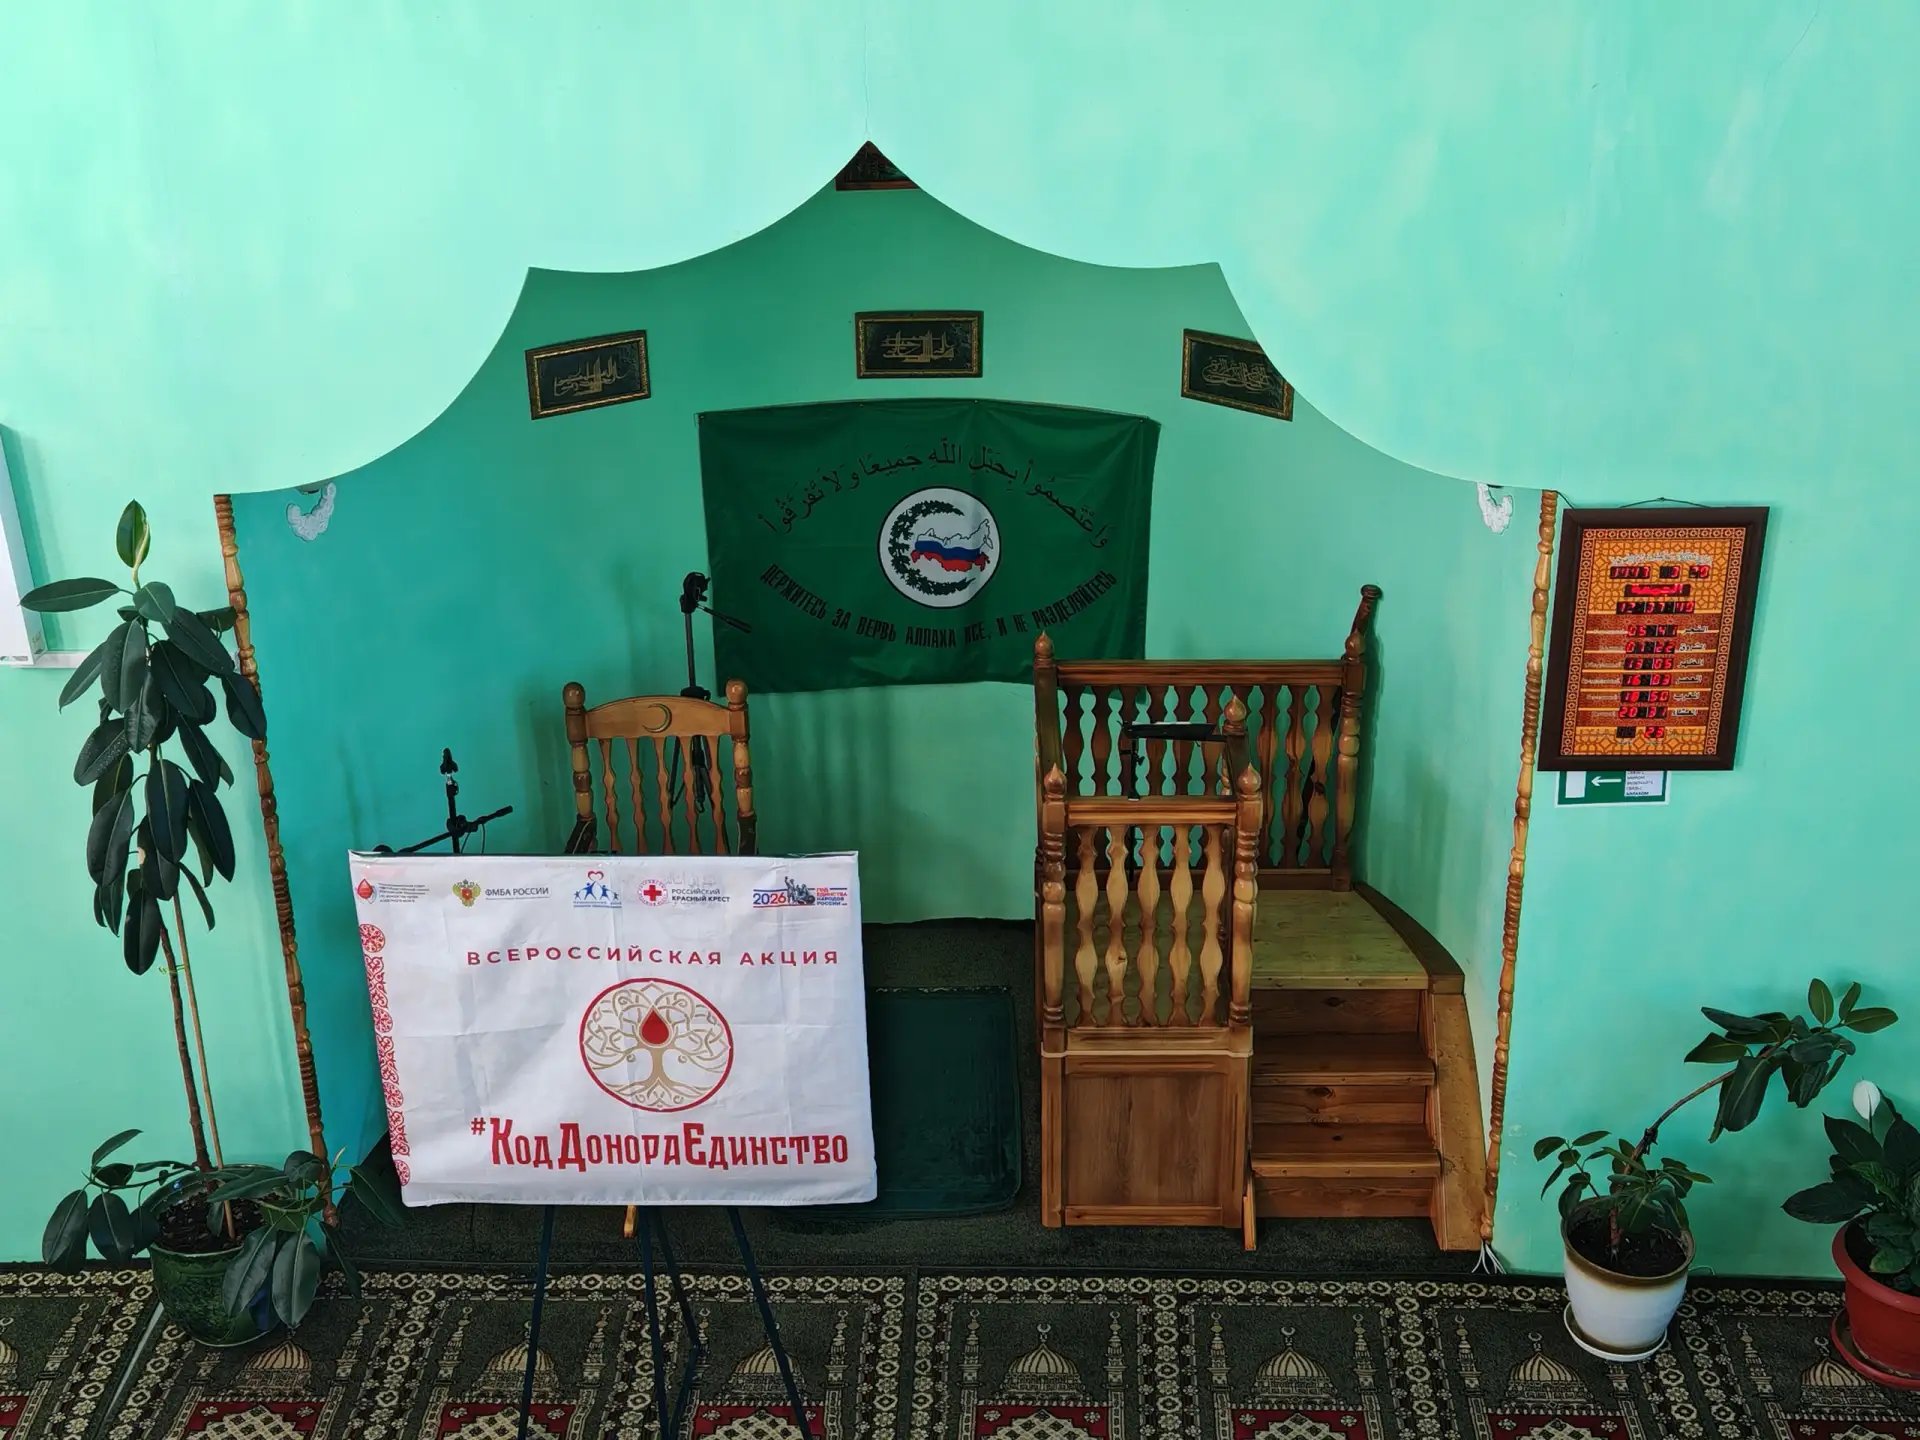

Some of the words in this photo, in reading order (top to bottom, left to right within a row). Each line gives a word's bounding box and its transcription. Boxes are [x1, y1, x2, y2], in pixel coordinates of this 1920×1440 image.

[760, 563, 828, 620] ДЕРЖИТЕСЬ
[832, 608, 852, 630] ЗА
[855, 616, 897, 642] ВЕРВЬ
[905, 626, 957, 648] АЛЛАХА
[996, 617, 1008, 637] И
[1013, 613, 1029, 633] НЕ
[1031, 570, 1117, 629] РАЗДЕЛЯЙТЕСЬ
[485, 887, 511, 897] ФМБА
[513, 886, 549, 896] РОССИИ
[671, 887, 721, 895] РОССИЙСКИЙ
[671, 894, 707, 902] КРАСНЫЙ
[753, 892, 787, 905] 2026
[467, 944, 722, 966] ВСЕРОССИЙСКАЯ
[739, 950, 838, 967] АКЦИЯ
